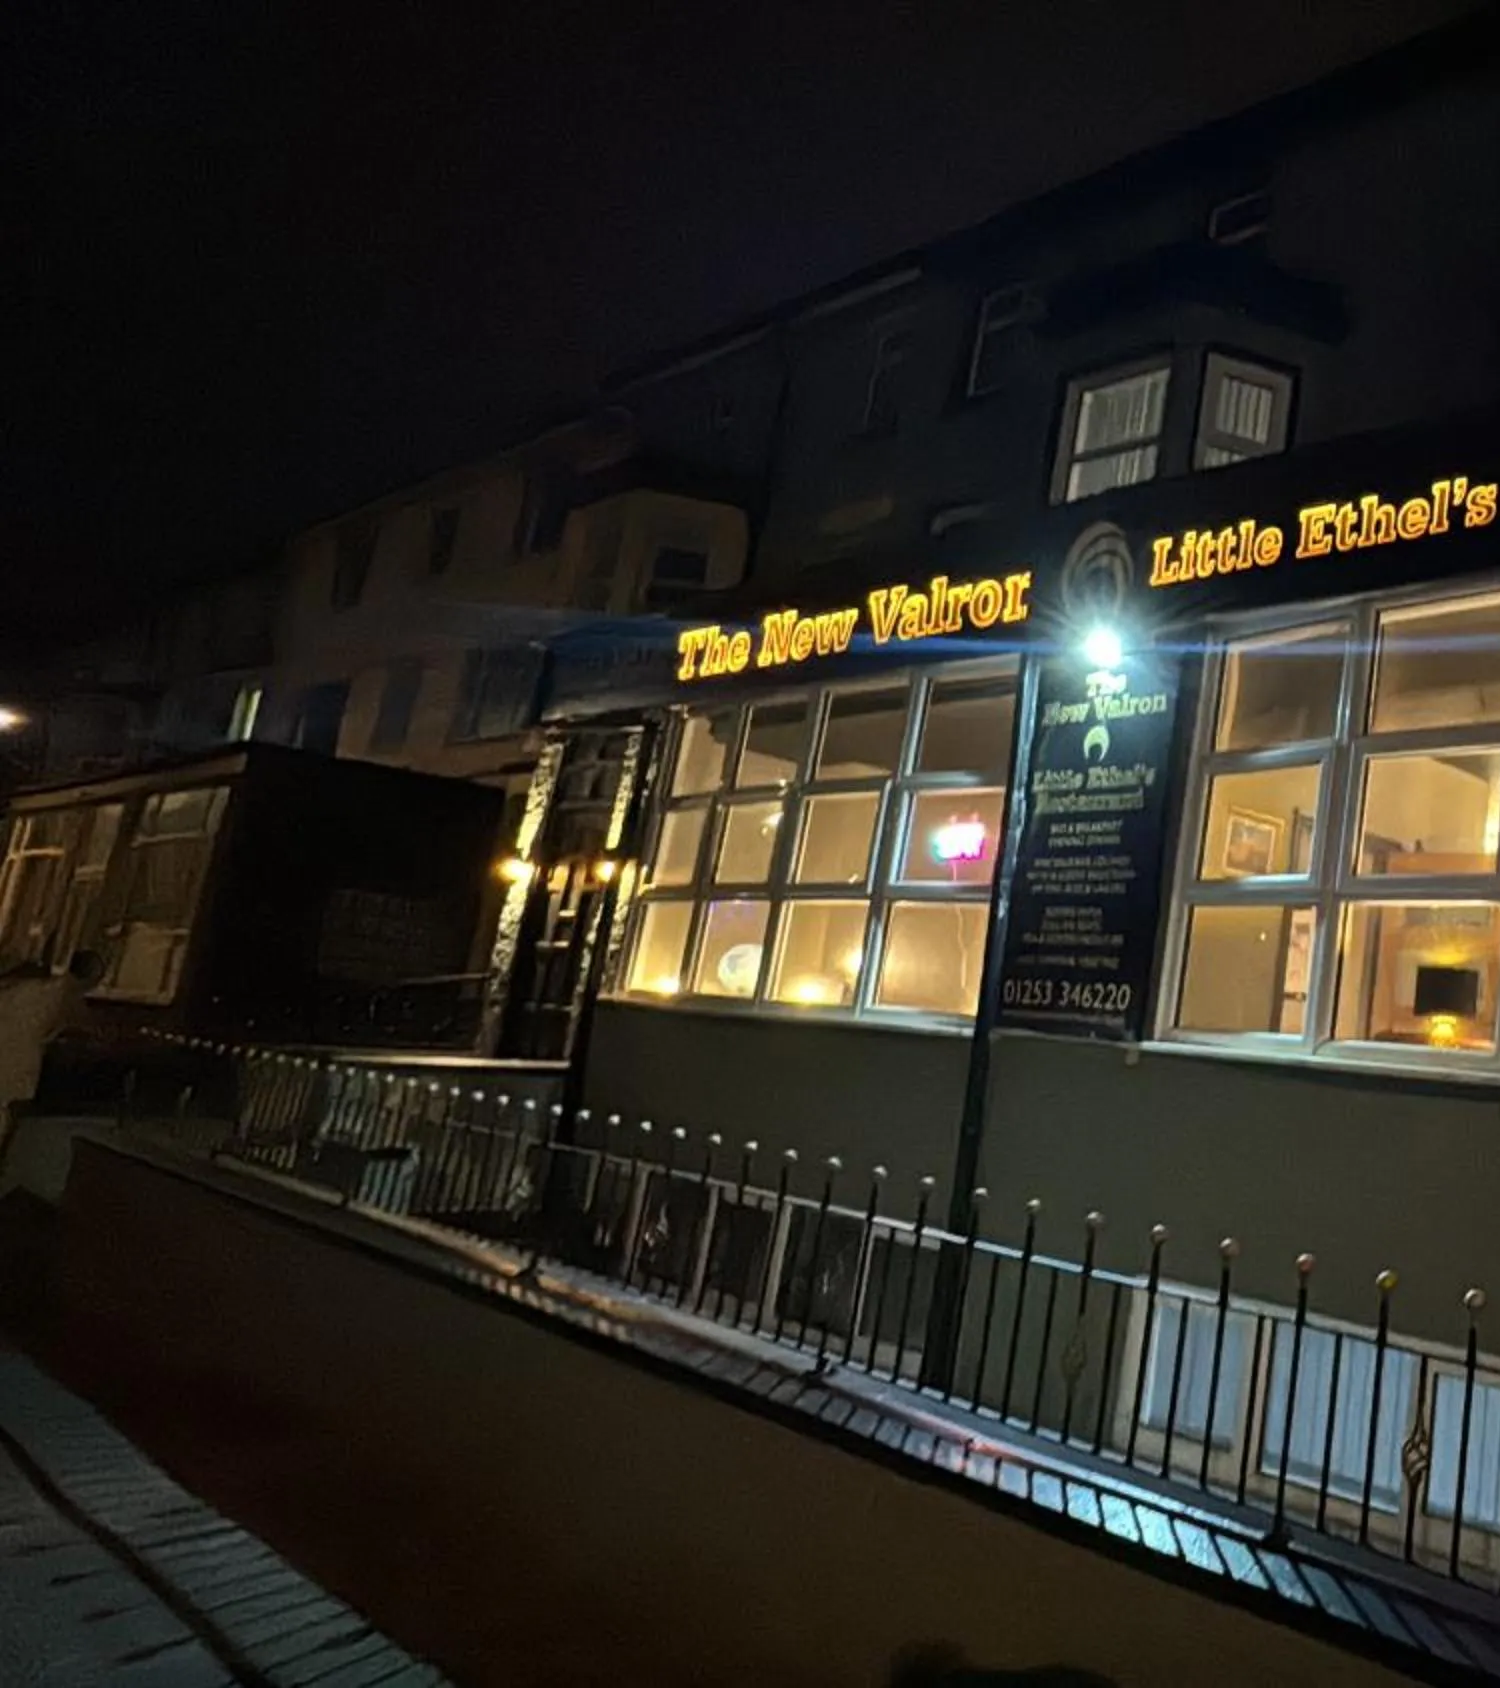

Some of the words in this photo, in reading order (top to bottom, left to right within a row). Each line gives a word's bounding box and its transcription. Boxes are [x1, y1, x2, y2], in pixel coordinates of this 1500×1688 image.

[1149, 519, 1283, 587] Little
[1296, 477, 1498, 560] Ethel's
[677, 624, 752, 681] The
[757, 608, 859, 668] New
[1092, 693, 1168, 721] Valron
[1003, 978, 1052, 1006] 01253
[1060, 980, 1132, 1012] 346220
